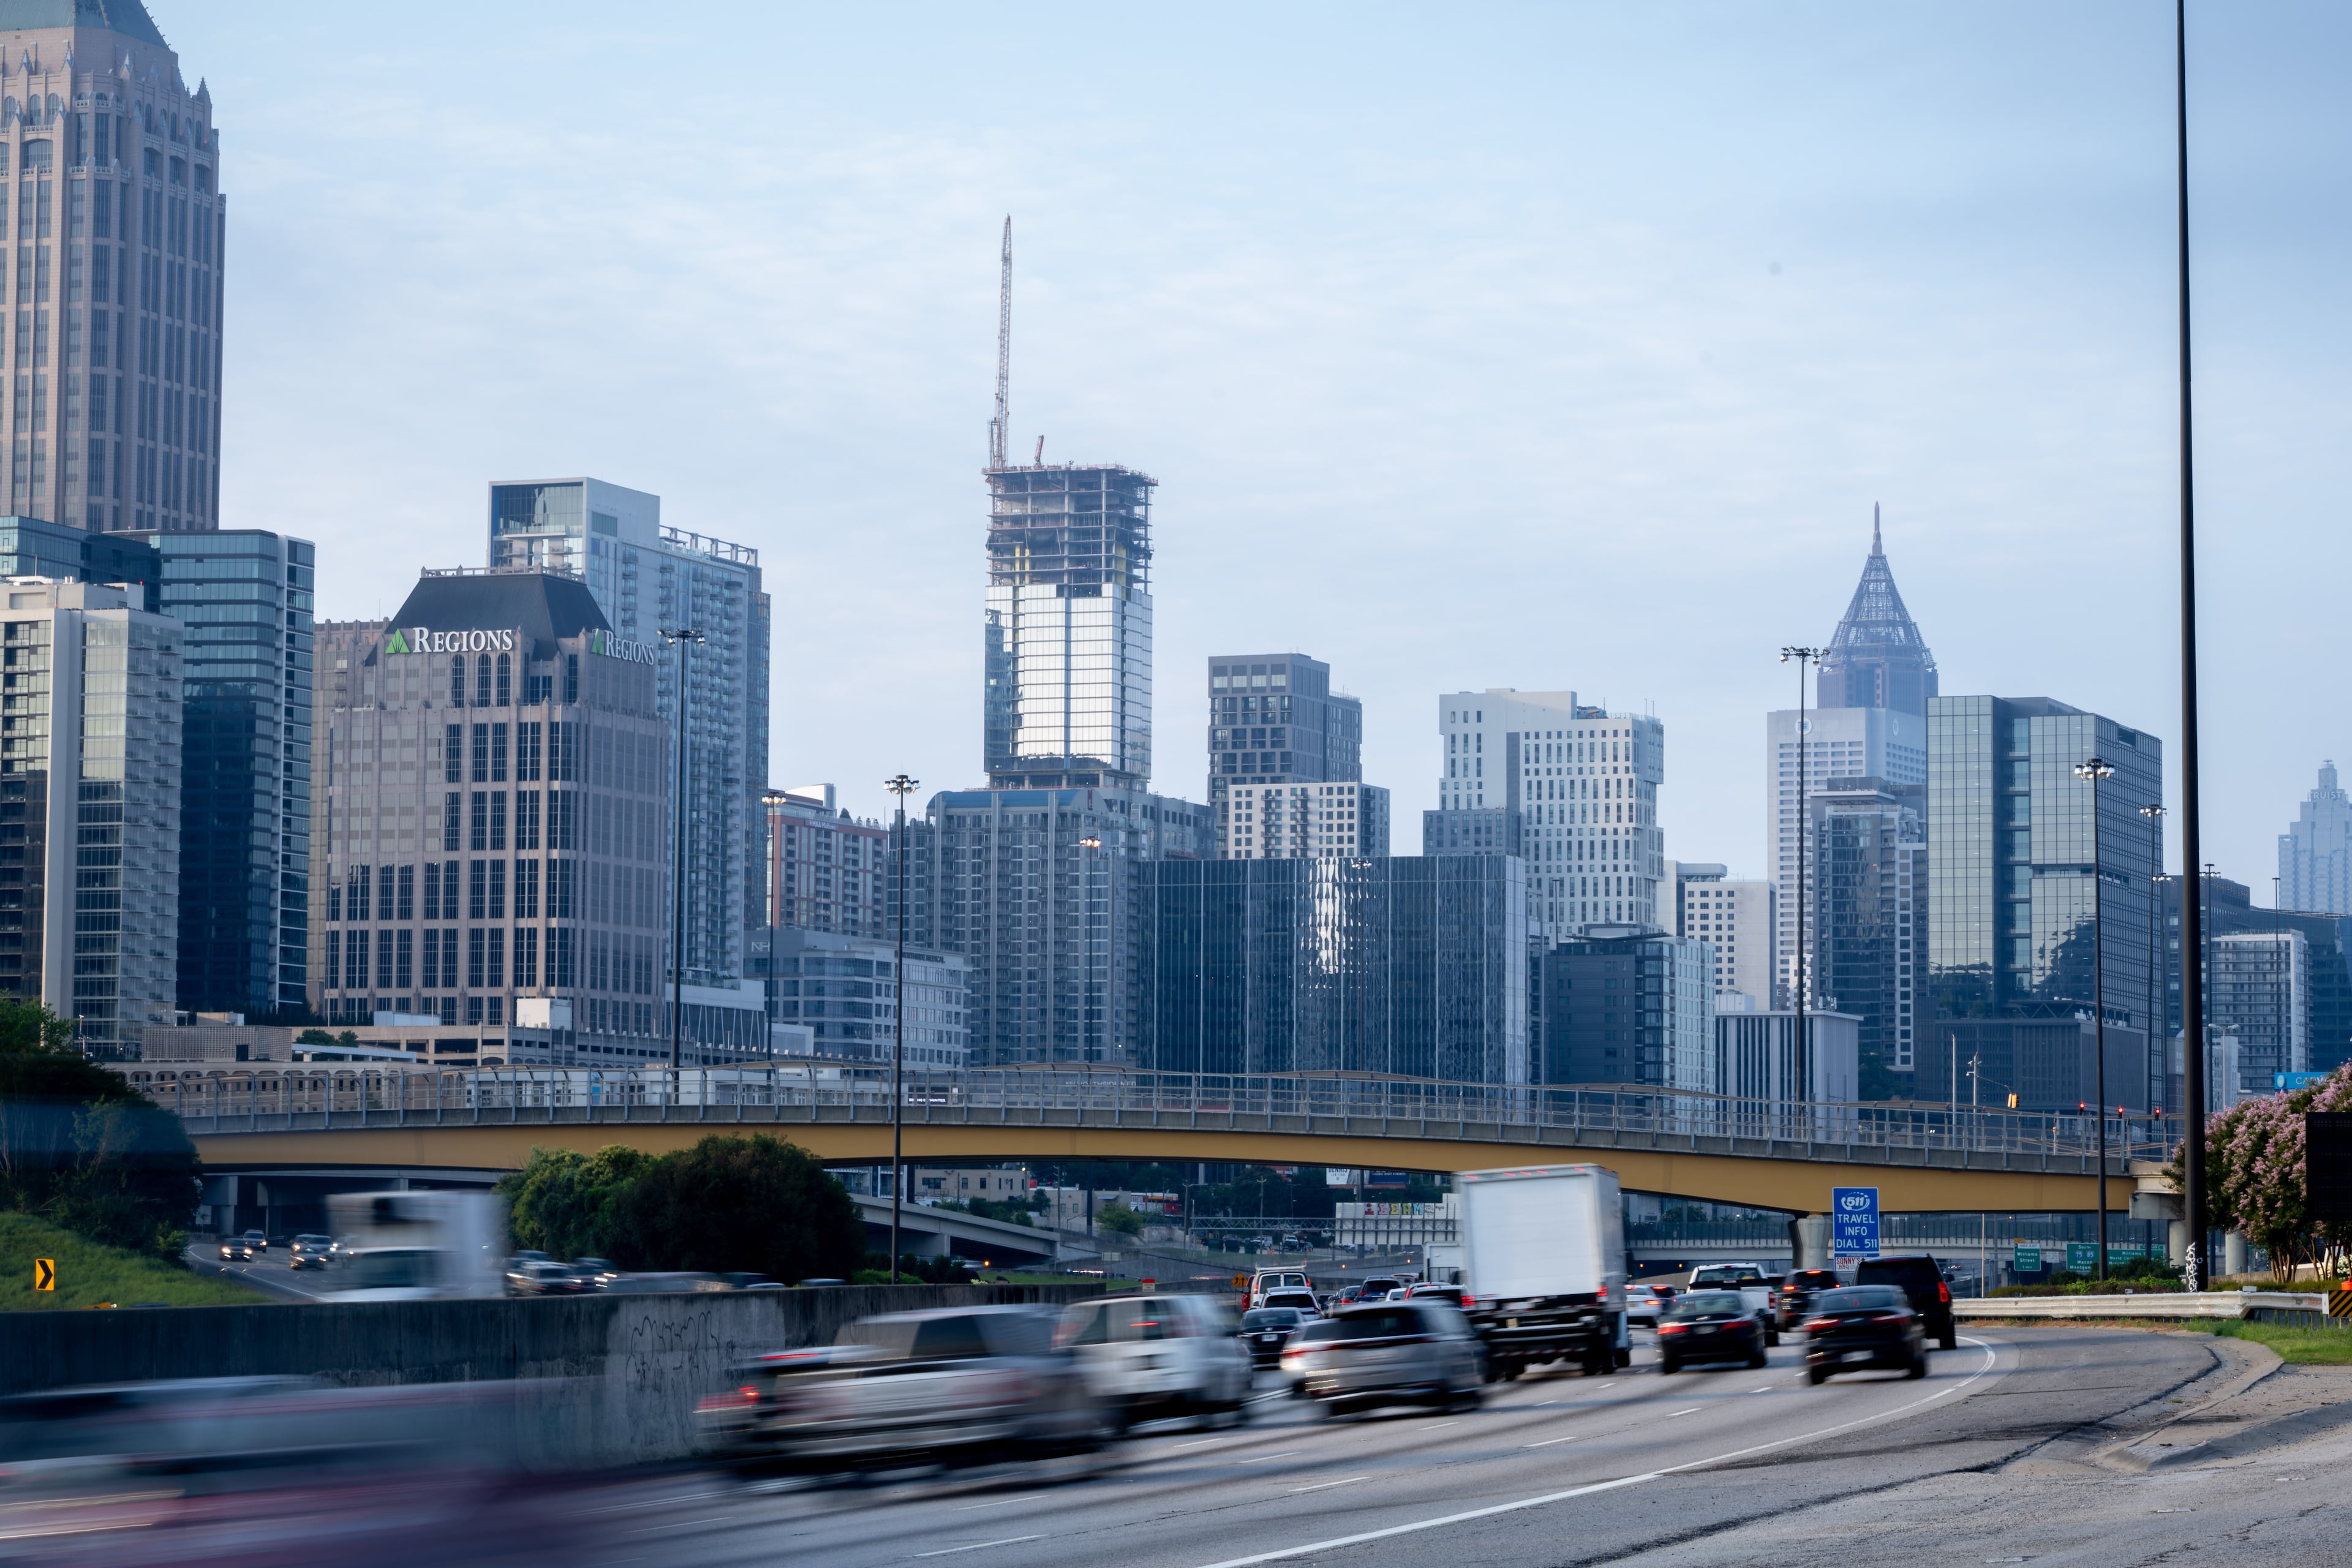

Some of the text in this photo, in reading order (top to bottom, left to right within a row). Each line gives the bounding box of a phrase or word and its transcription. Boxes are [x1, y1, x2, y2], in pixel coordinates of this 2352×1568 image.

[412, 627, 513, 653] REGIONS
[605, 630, 655, 666] REGIONS
[1846, 1196, 1864, 1207] 511
[1837, 1214, 1875, 1224] TRAVEL
[1844, 1226, 1868, 1236] INFO
[1836, 1238, 1877, 1248] DIAL 511
